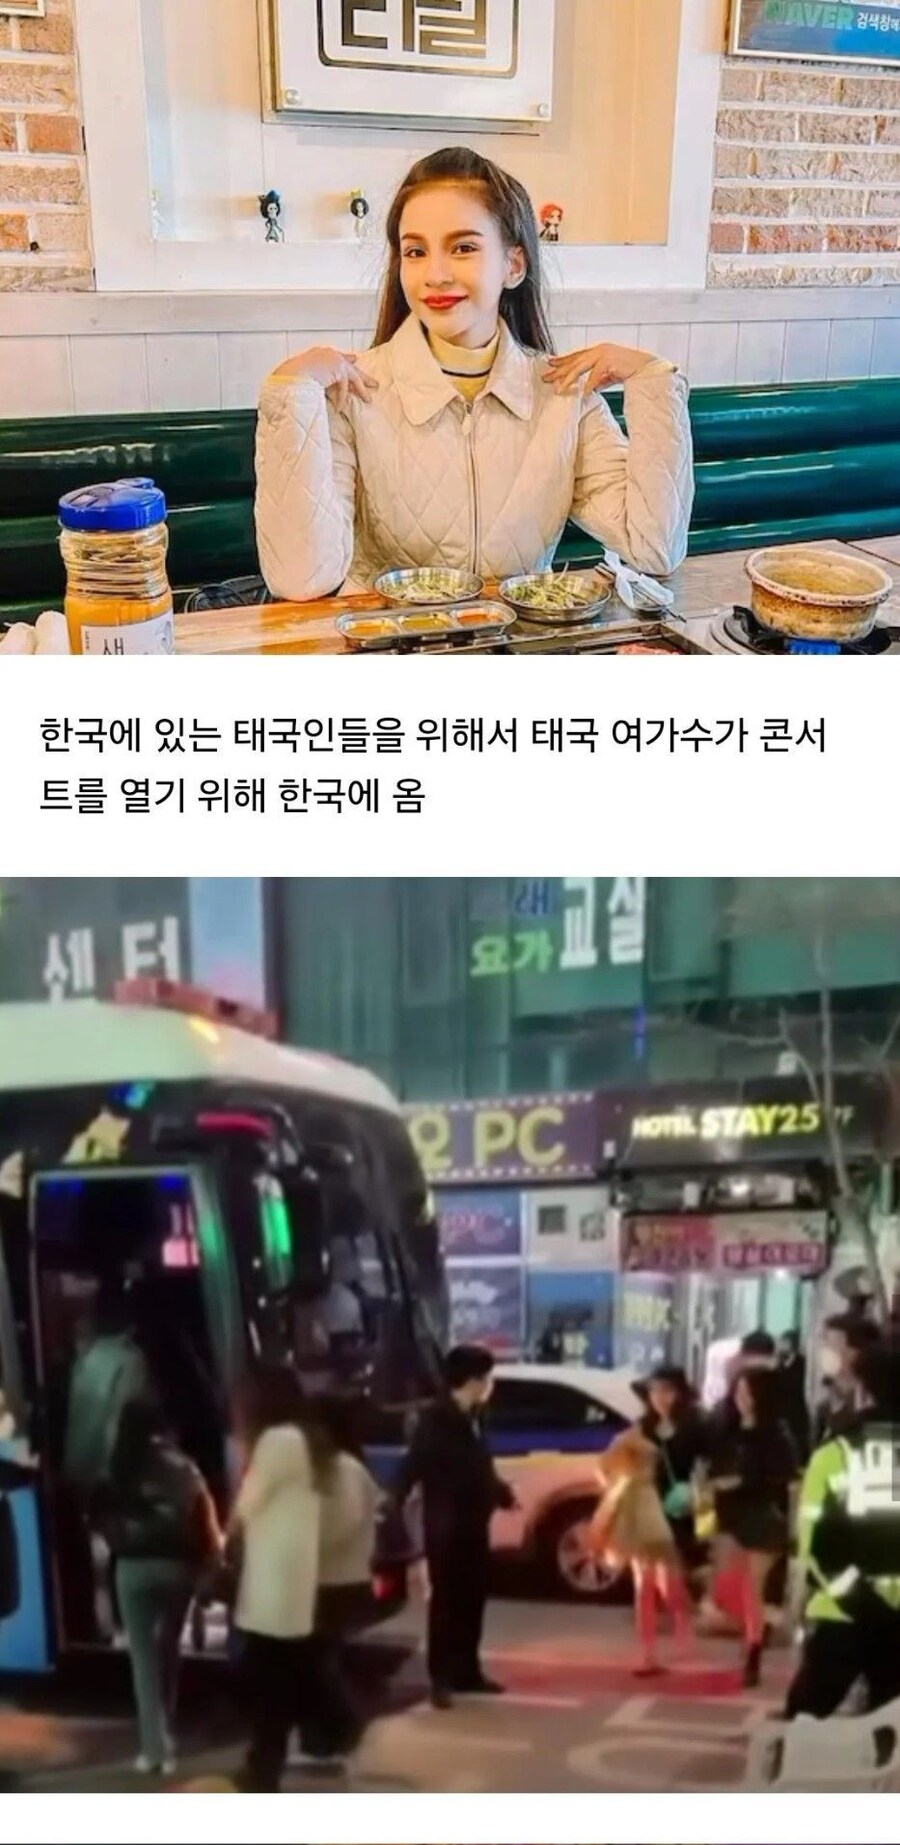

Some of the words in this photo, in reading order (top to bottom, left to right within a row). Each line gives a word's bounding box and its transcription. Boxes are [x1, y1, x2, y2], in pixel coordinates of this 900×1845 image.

[764, 1, 854, 30] NAVER
[473, 1106, 567, 1168] PC
[631, 1112, 699, 1139] HOTEL
[700, 1103, 820, 1139] STAY25
